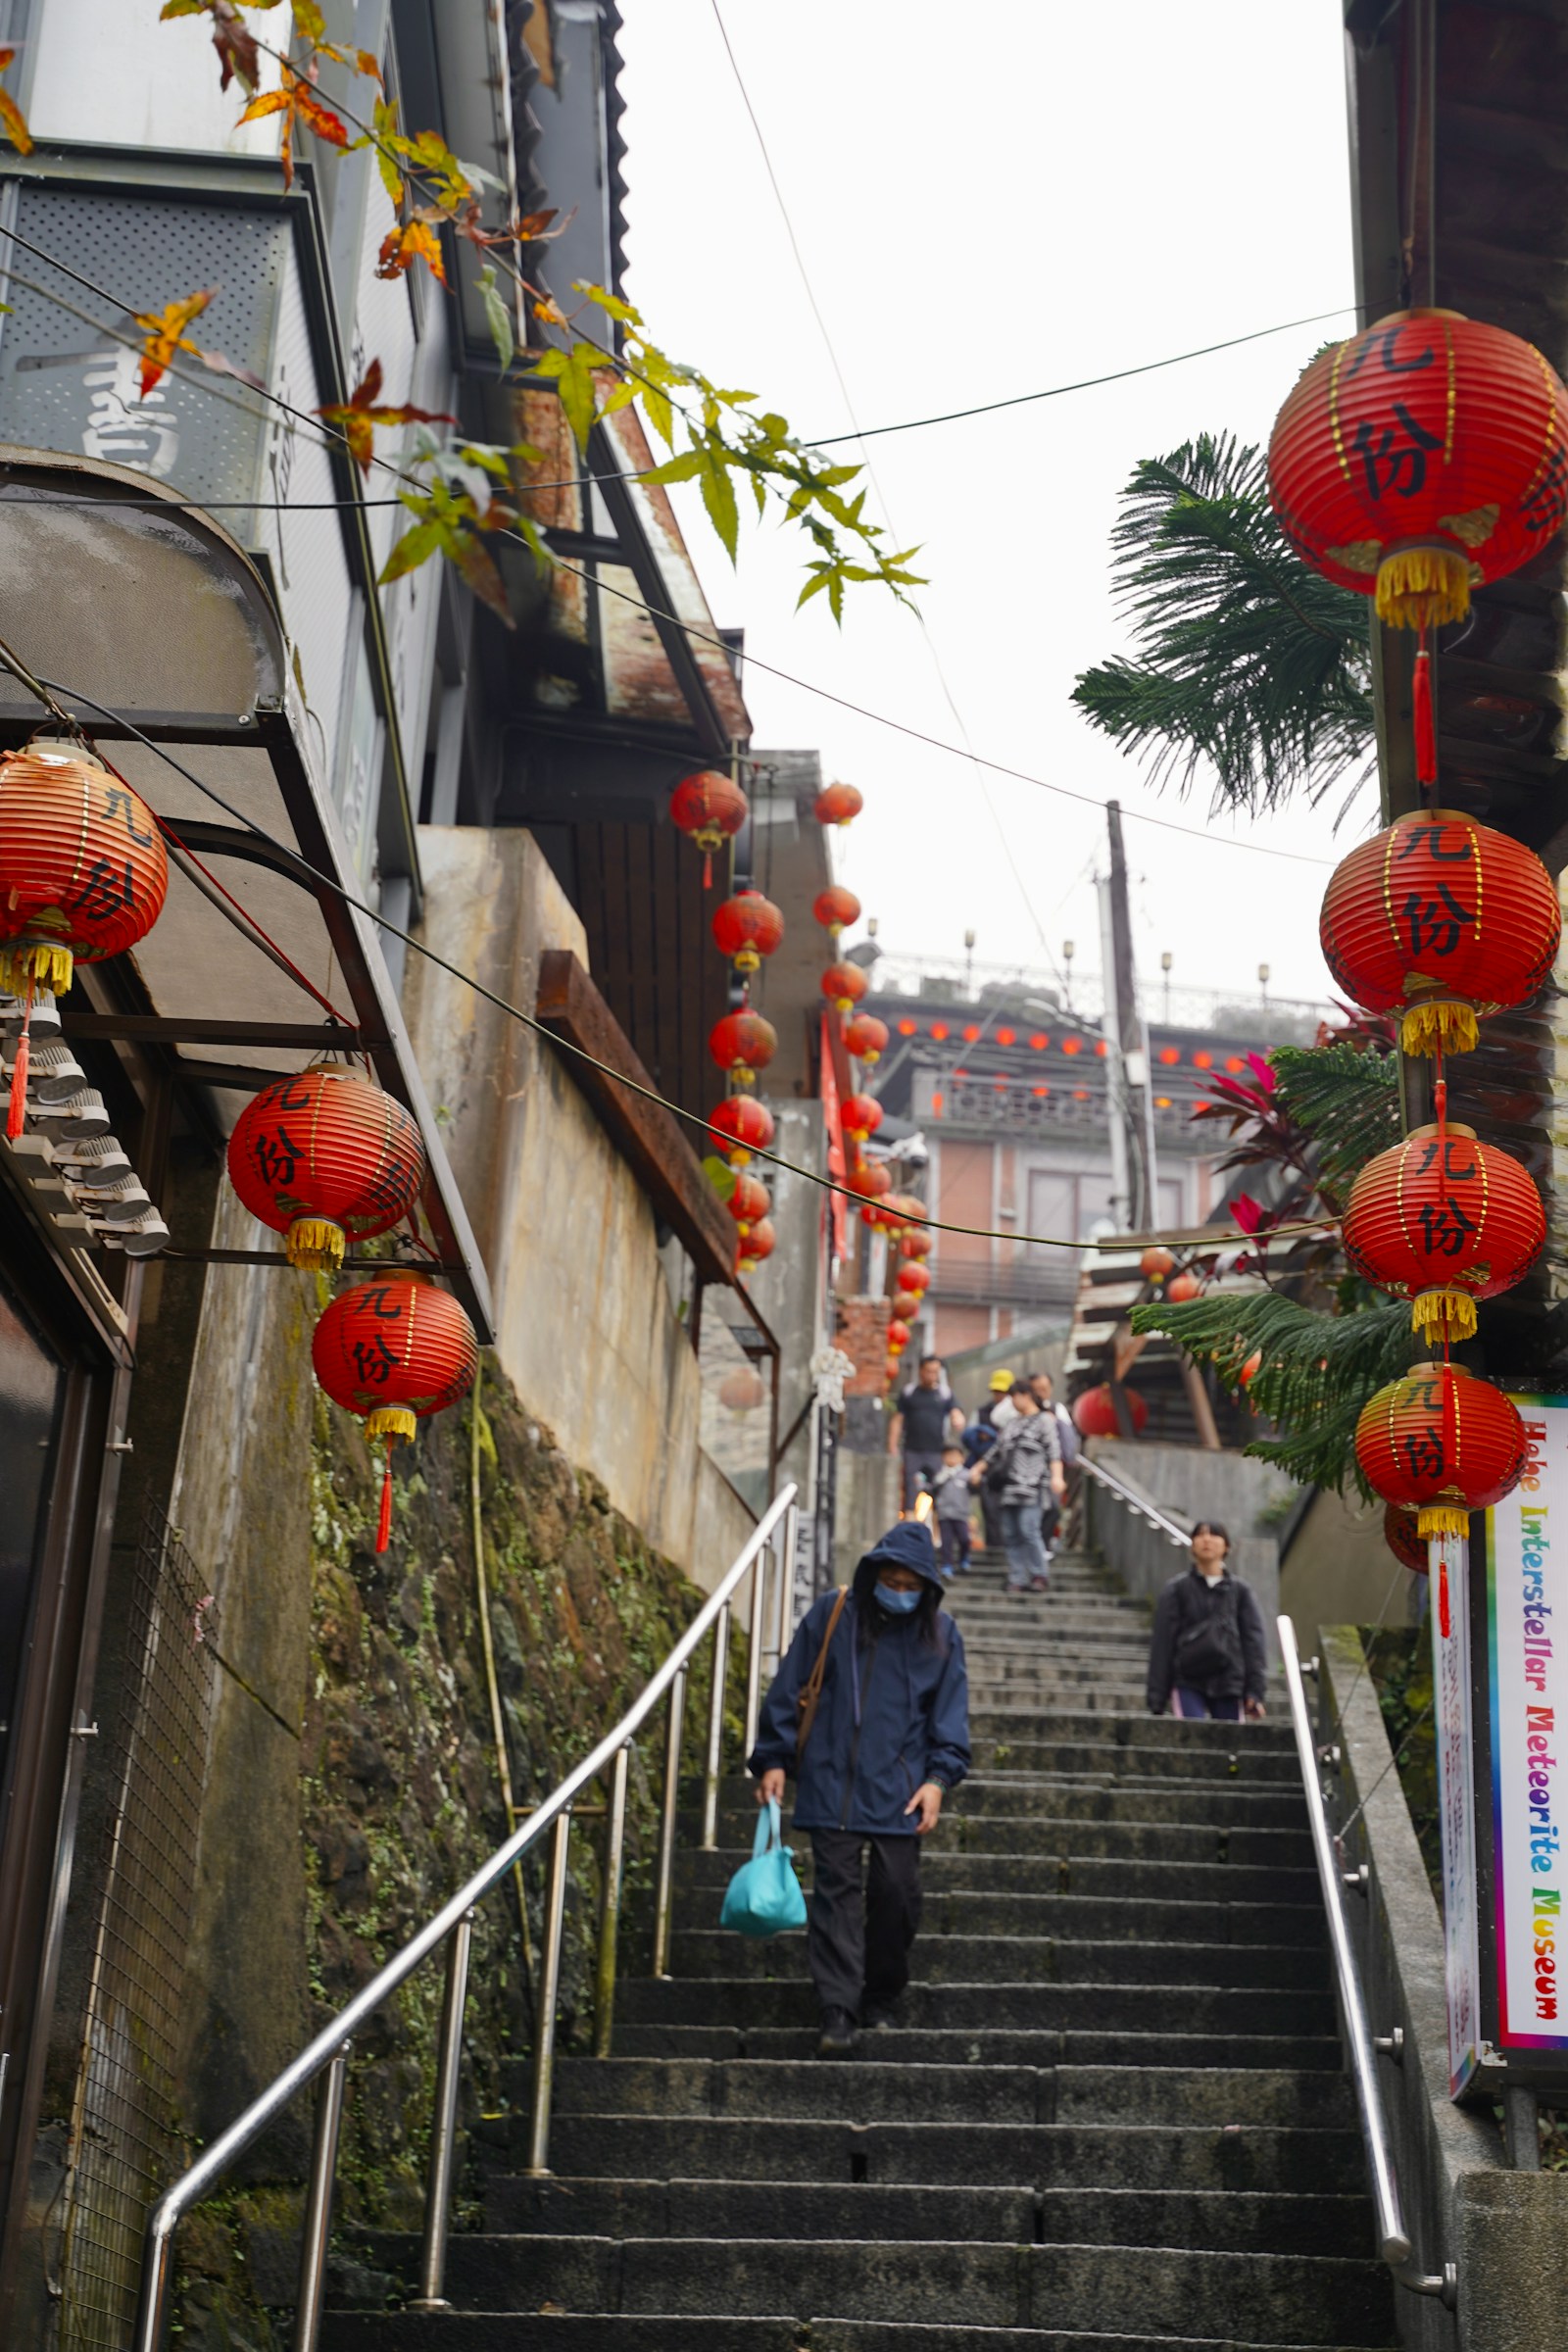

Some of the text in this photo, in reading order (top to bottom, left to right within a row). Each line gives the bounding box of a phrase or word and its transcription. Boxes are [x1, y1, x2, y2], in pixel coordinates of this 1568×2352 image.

[1345, 325, 1445, 501] 九份
[72, 787, 152, 920] 九份
[1397, 825, 1475, 956] 九份
[255, 1077, 310, 1185] 九份
[1416, 1142, 1477, 1256] 九份
[353, 1286, 402, 1384] 九份
[1402, 1380, 1446, 1479] 九份
[1520, 1504, 1553, 1692] Interstellar
[1527, 1704, 1560, 1873] Meteorite
[1532, 1886, 1561, 2021] Museum
